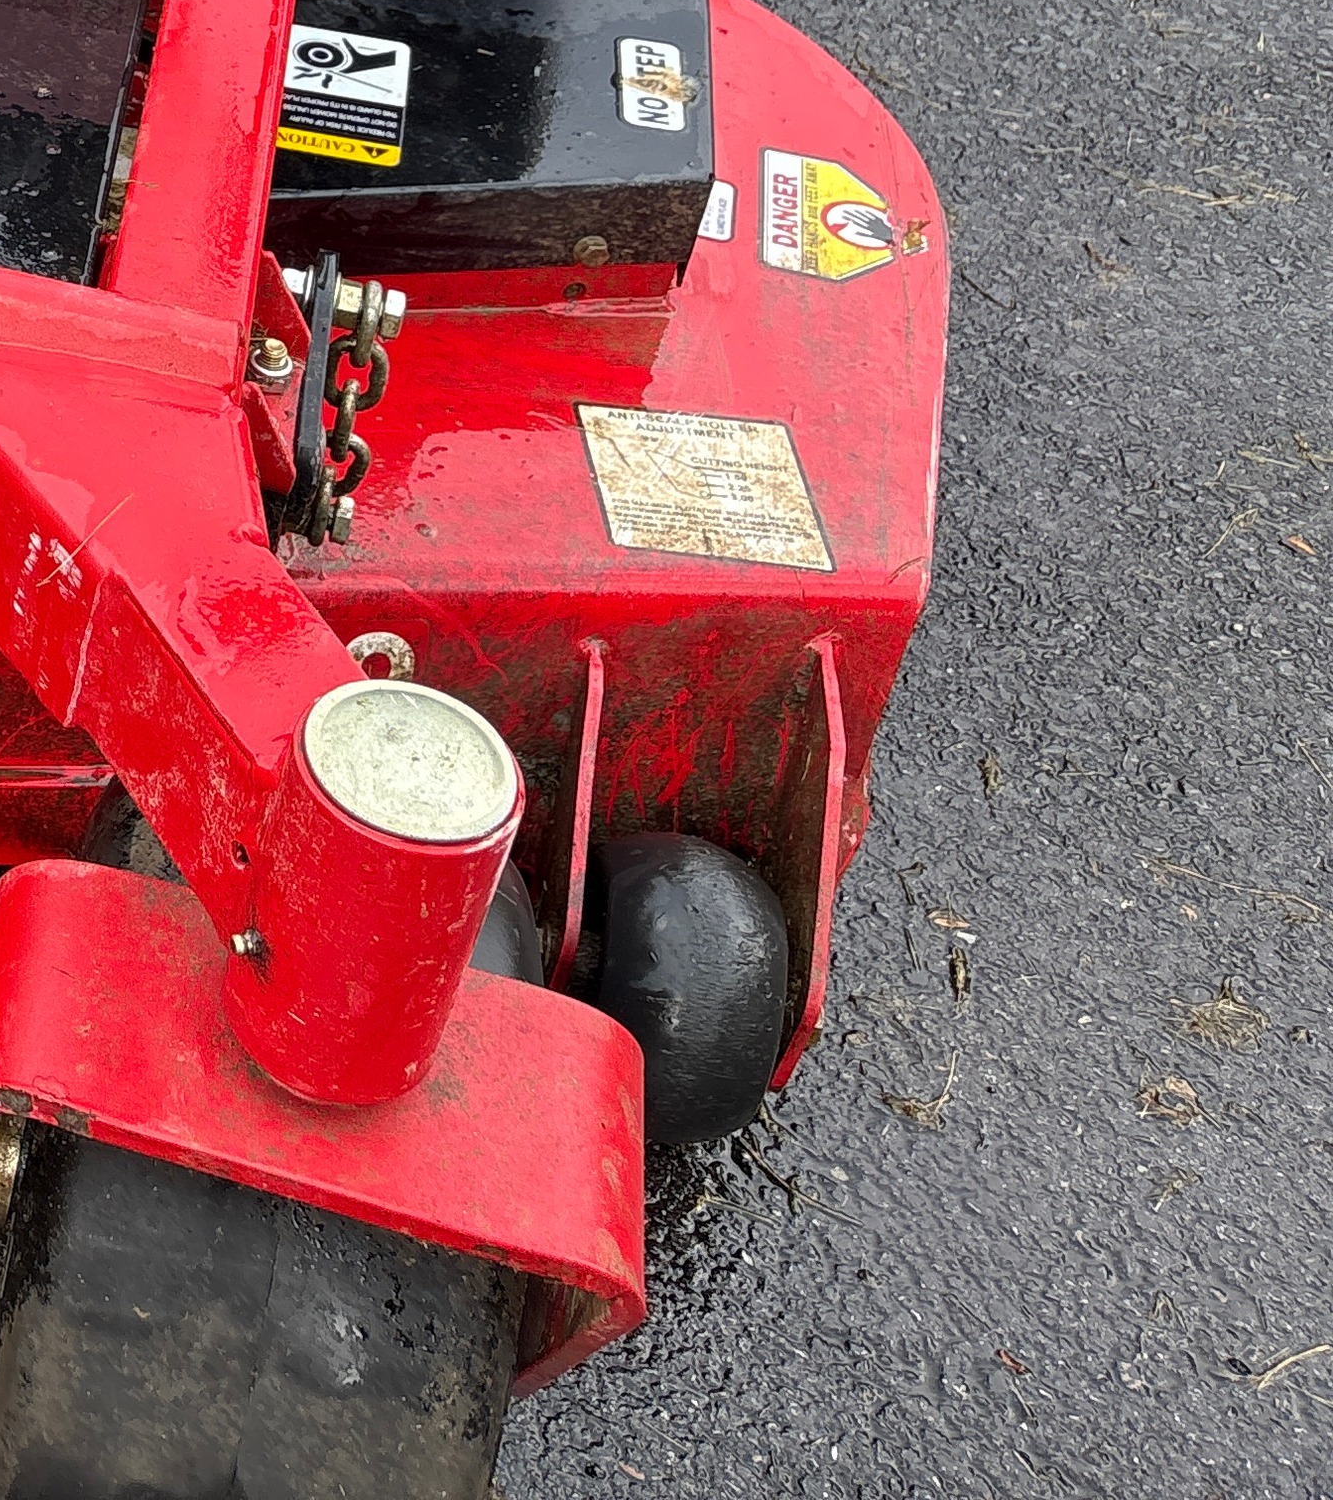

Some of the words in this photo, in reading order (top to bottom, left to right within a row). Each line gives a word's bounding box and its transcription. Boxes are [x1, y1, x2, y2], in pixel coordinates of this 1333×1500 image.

[635, 44, 669, 94] STEP
[637, 97, 669, 125] NO
[277, 132, 356, 153] CAUTION
[772, 173, 798, 249] DANGER
